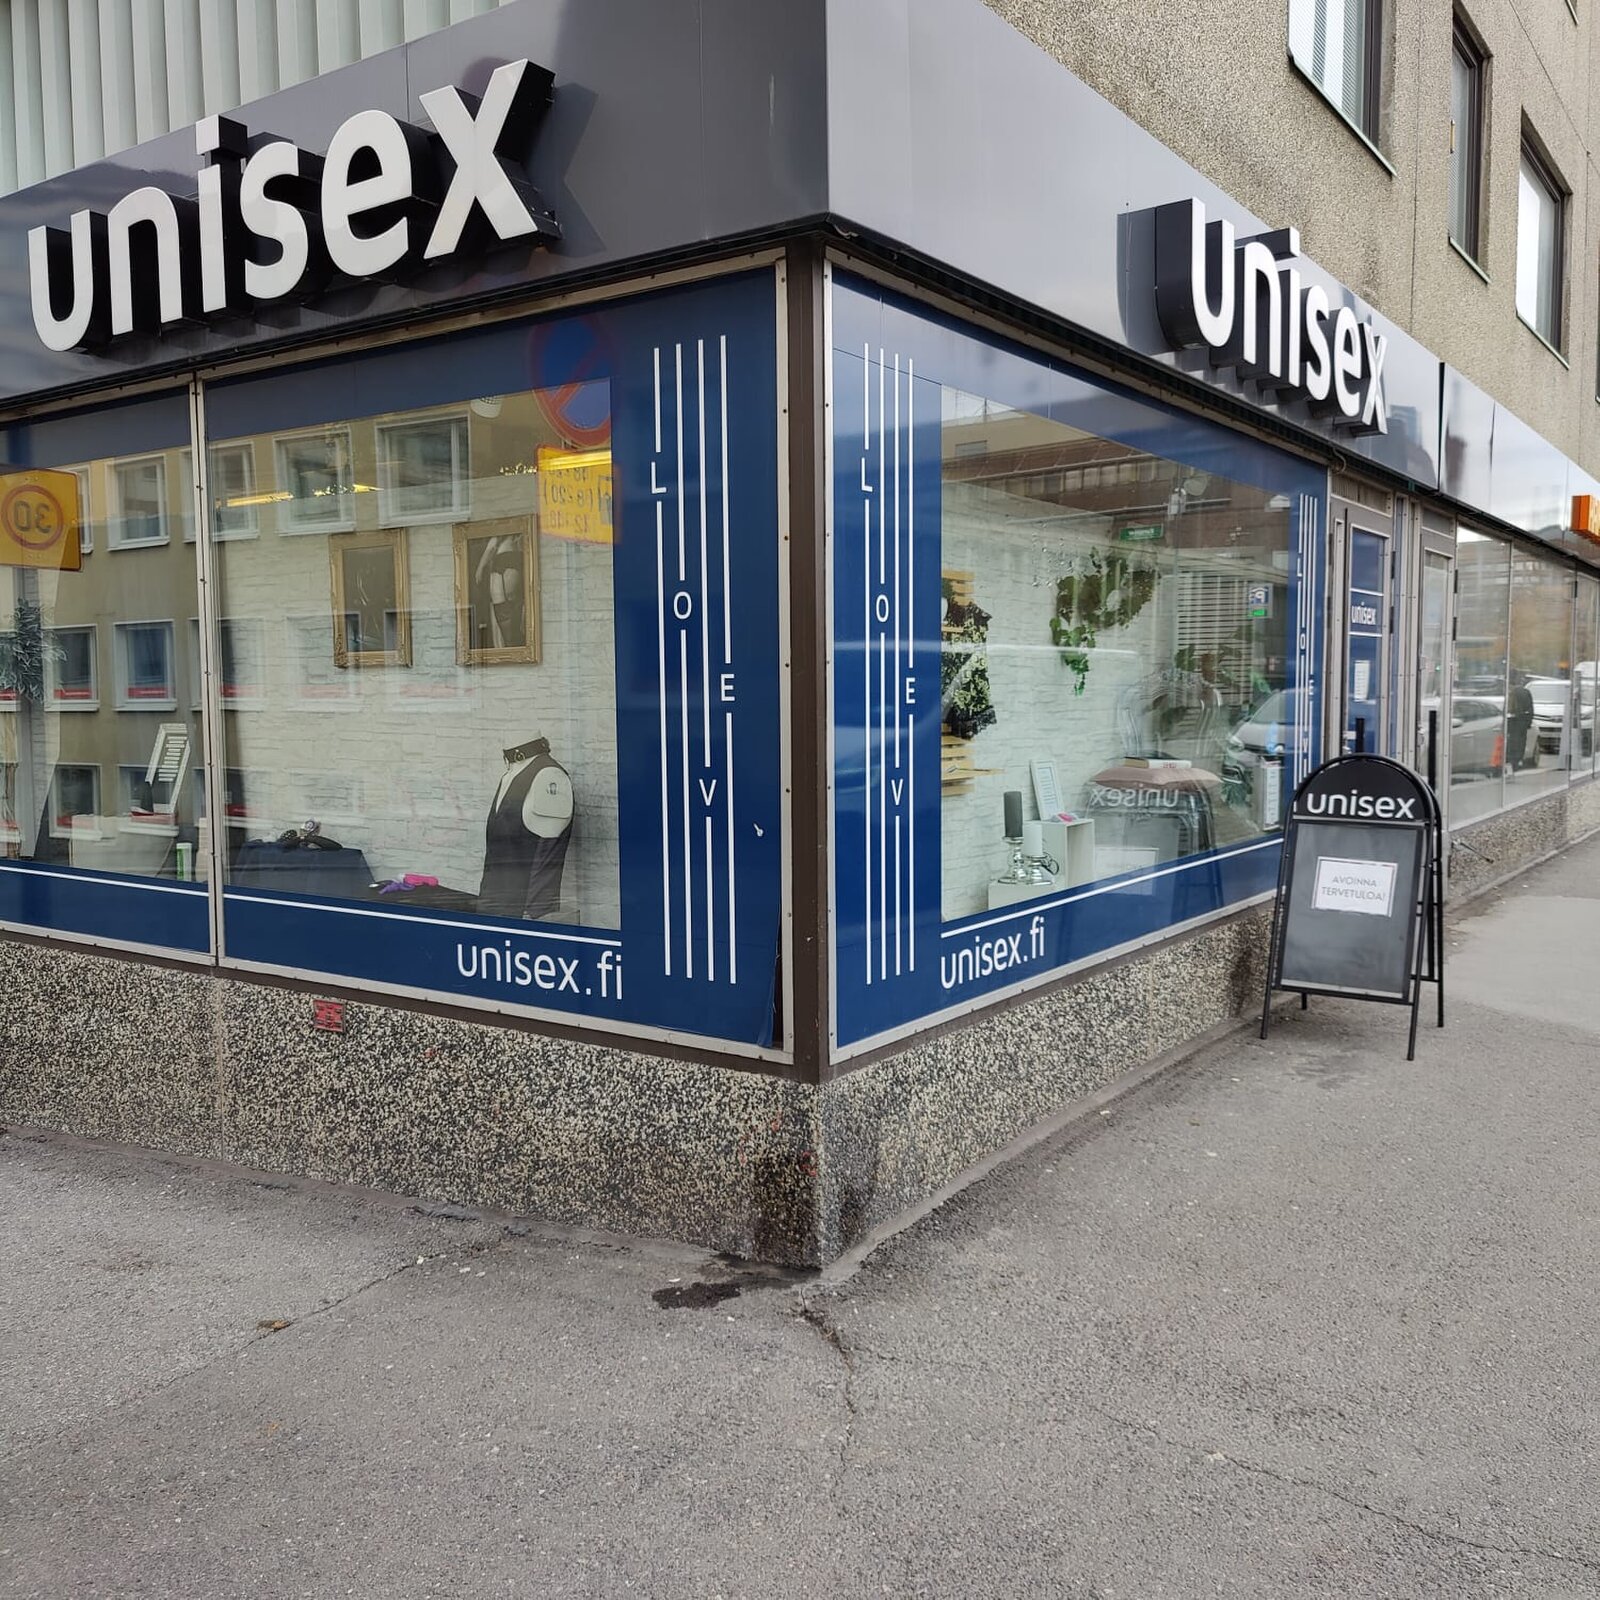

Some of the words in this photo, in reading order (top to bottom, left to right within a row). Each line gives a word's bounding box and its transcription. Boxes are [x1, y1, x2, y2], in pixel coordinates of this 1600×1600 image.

[28, 59, 538, 352] unisex
[1191, 197, 1388, 435] unisex
[1351, 601, 1377, 625] unisex
[1307, 789, 1416, 819] unisex
[1321, 886, 1386, 901] TERVETULOA!
[1332, 875, 1377, 887] AVOINNA
[456, 940, 622, 1000] unisex.fi
[940, 915, 1045, 990] unisex.fi
